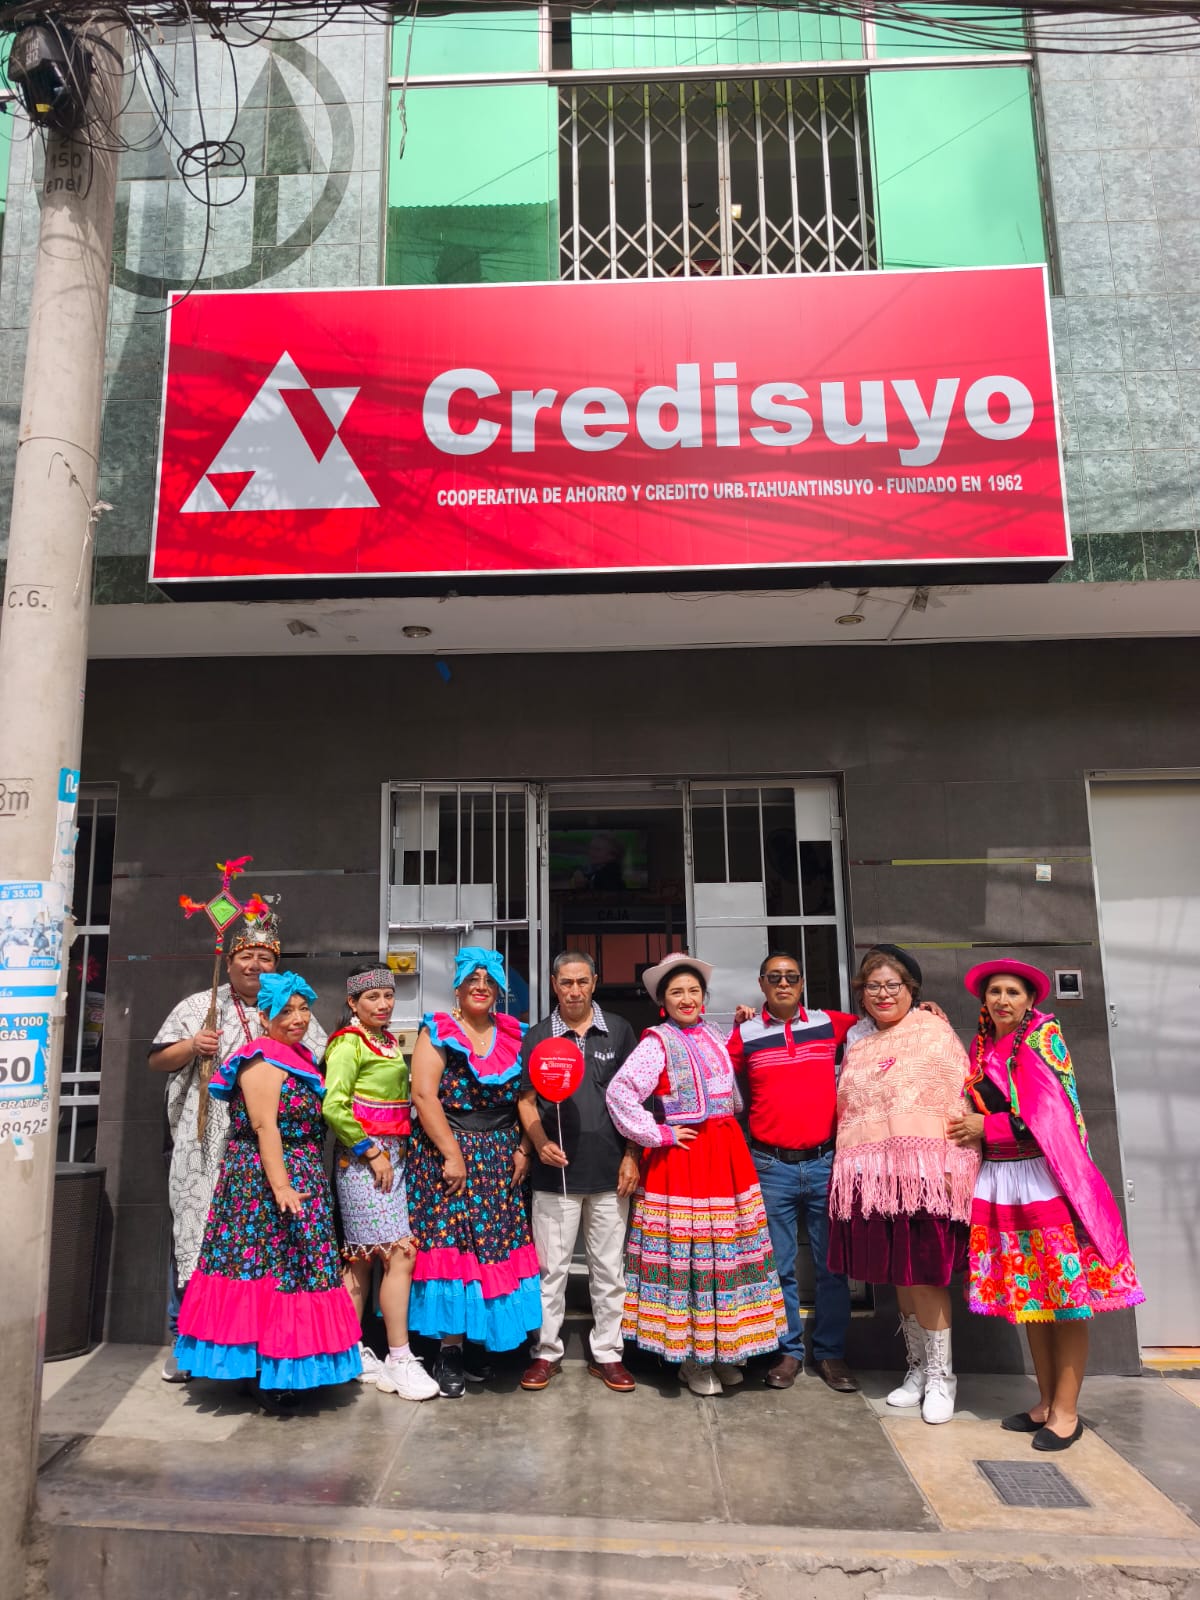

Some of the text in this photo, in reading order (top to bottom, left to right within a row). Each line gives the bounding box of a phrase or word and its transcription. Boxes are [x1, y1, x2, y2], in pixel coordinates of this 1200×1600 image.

[52, 152, 82, 169] 150
[46, 175, 82, 194] enel
[422, 362, 1035, 466] Credisuyo
[437, 487, 538, 507] COOPERATIVA
[543, 487, 562, 504] DE
[565, 485, 627, 503] AHORRO
[631, 485, 641, 501] Y
[645, 482, 709, 501] CREDITO
[887, 476, 957, 494] FUNDADO
[962, 475, 981, 492] EN
[988, 474, 1023, 491] 1962
[14, 1015, 44, 1026] 1000
